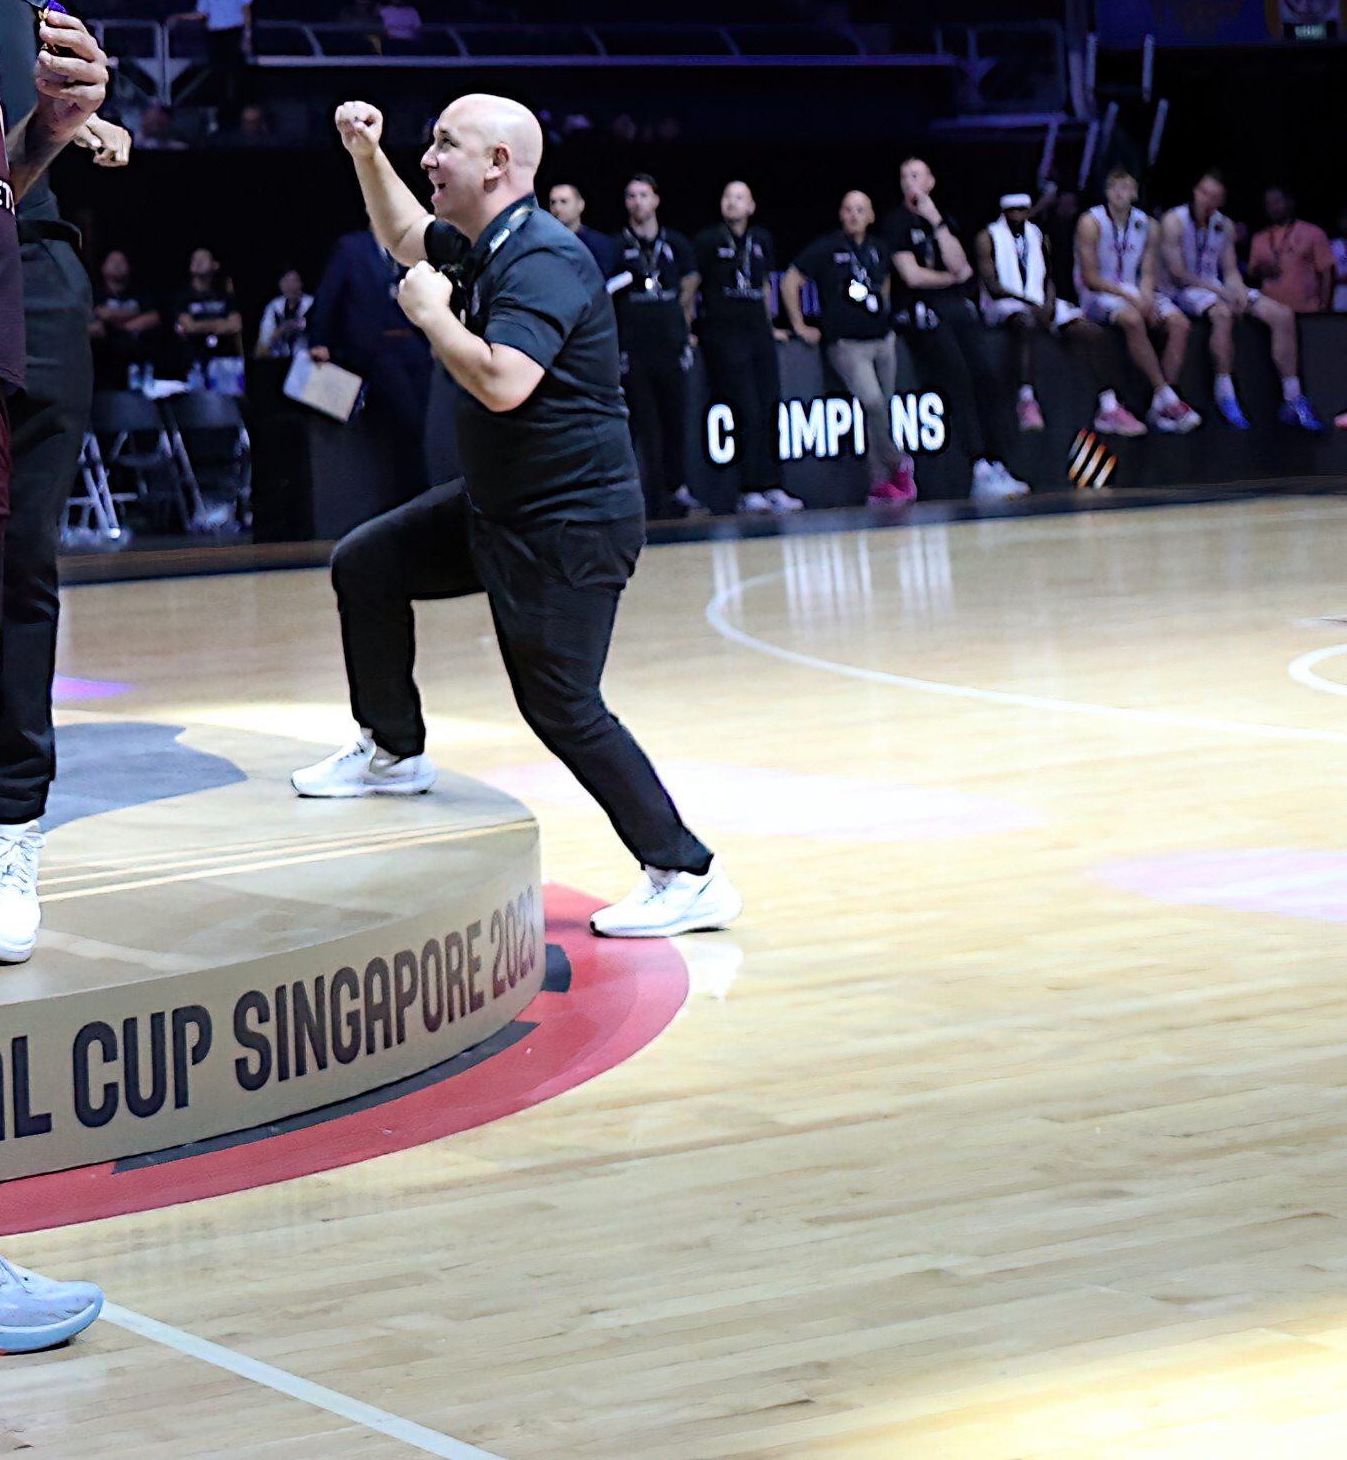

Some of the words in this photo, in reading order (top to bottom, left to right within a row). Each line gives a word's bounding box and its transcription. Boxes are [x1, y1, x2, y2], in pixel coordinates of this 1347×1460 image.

[707, 391, 946, 465] CMPINS
[72, 1003, 212, 1130] CUP
[233, 919, 486, 1094] SINGAPORE
